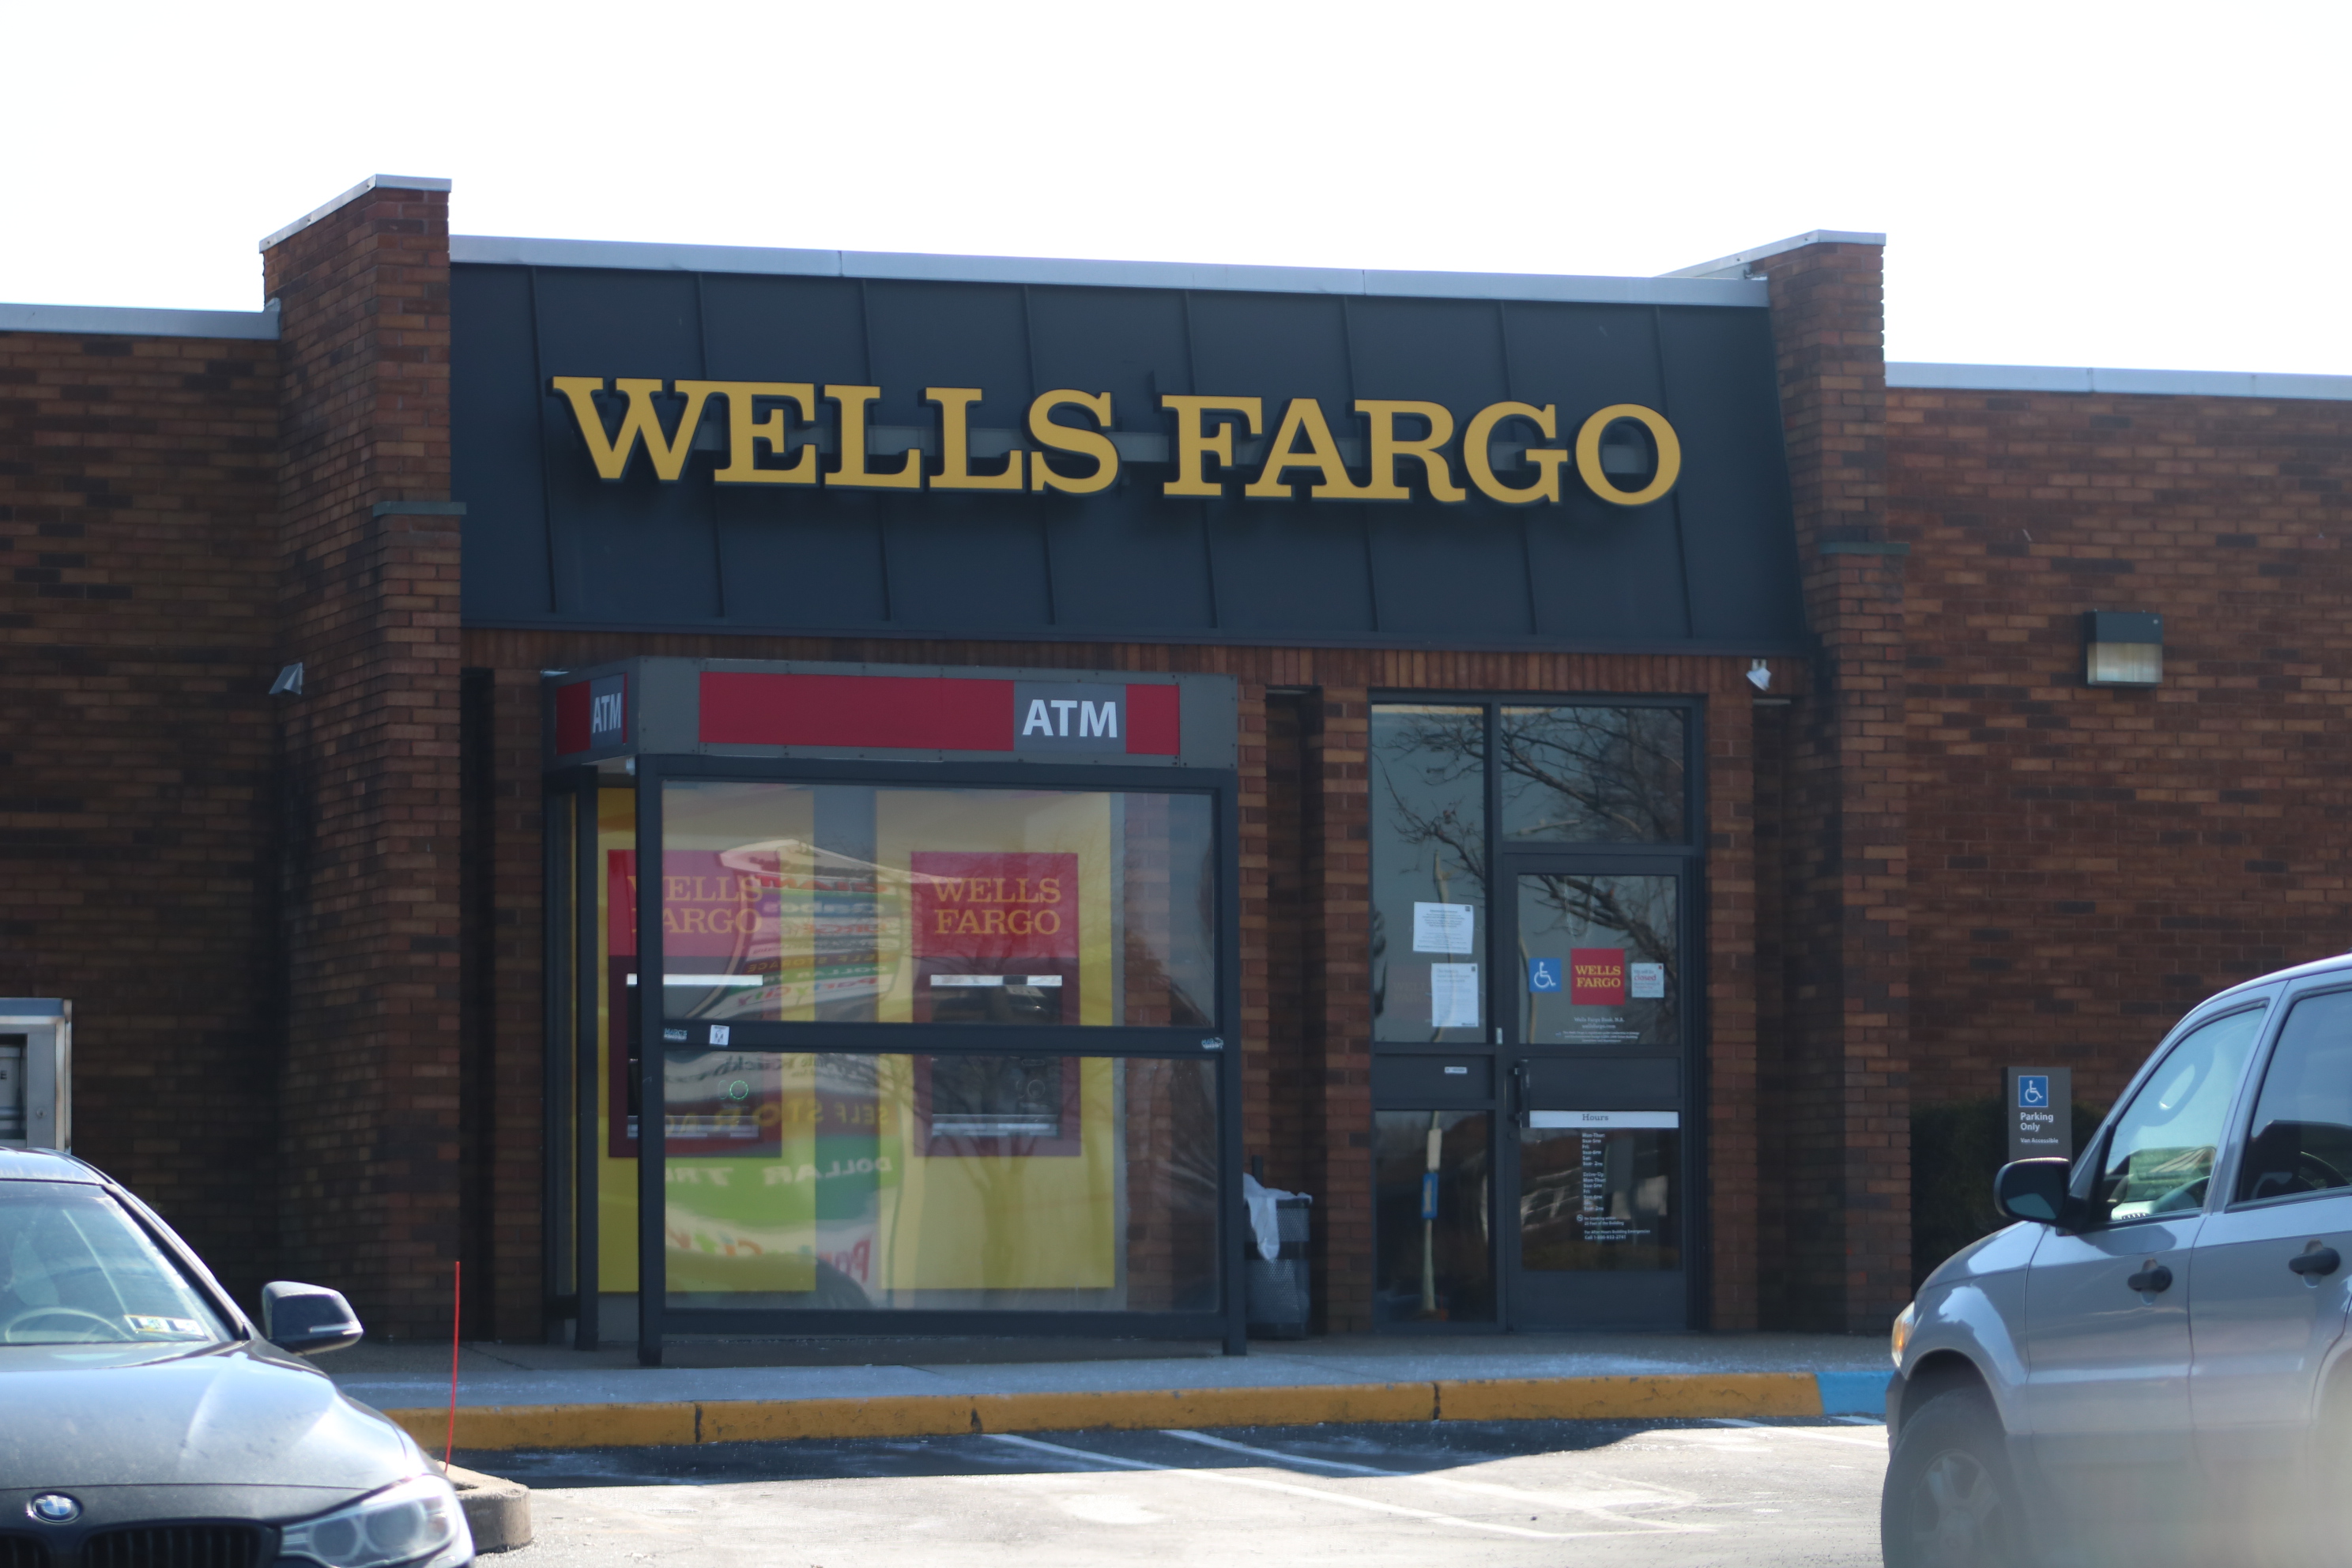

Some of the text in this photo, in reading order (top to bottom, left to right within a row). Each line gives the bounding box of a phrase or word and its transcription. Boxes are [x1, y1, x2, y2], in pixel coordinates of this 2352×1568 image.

[552, 375, 1682, 506] WELLS FARGO
[592, 692, 622, 734] ATM
[1021, 699, 1118, 738] ATM
[929, 876, 1061, 903] WELLS
[631, 907, 763, 935] ARGO
[934, 909, 1061, 935] FARGO
[1574, 965, 1622, 976] WELLS
[1576, 977, 1622, 988] FARGO
[1582, 1113, 1609, 1121] Hours
[2020, 1111, 2054, 1123] Parking
[2020, 1122, 2041, 1133] Only
